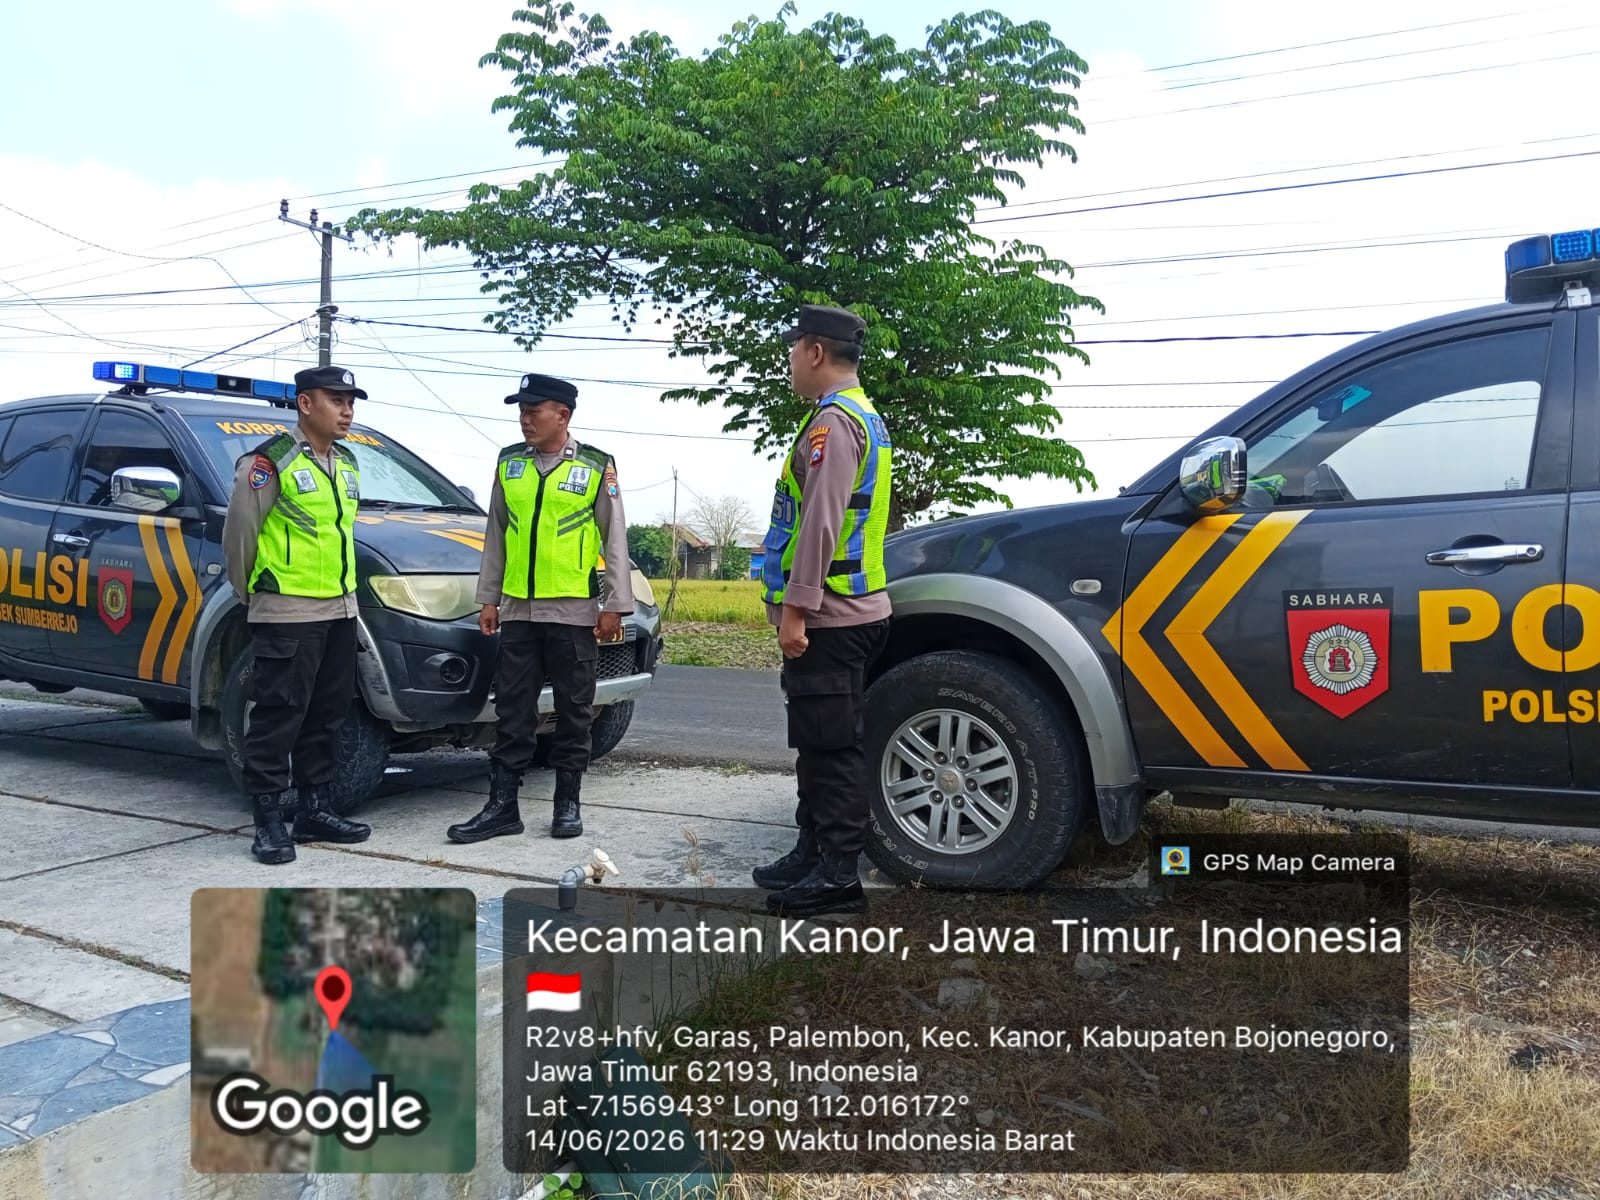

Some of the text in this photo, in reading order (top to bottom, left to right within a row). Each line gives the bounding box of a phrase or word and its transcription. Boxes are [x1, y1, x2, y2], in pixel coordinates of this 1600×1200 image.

[216, 421, 289, 435] KORPS
[558, 483, 586, 495] POLISI
[1289, 592, 1384, 606] SABHARA
[15, 605, 78, 634] SUMBERREJO
[1483, 689, 1600, 723] POLS
[937, 687, 1017, 735] SAVERO
[1028, 788, 1038, 820] PRO
